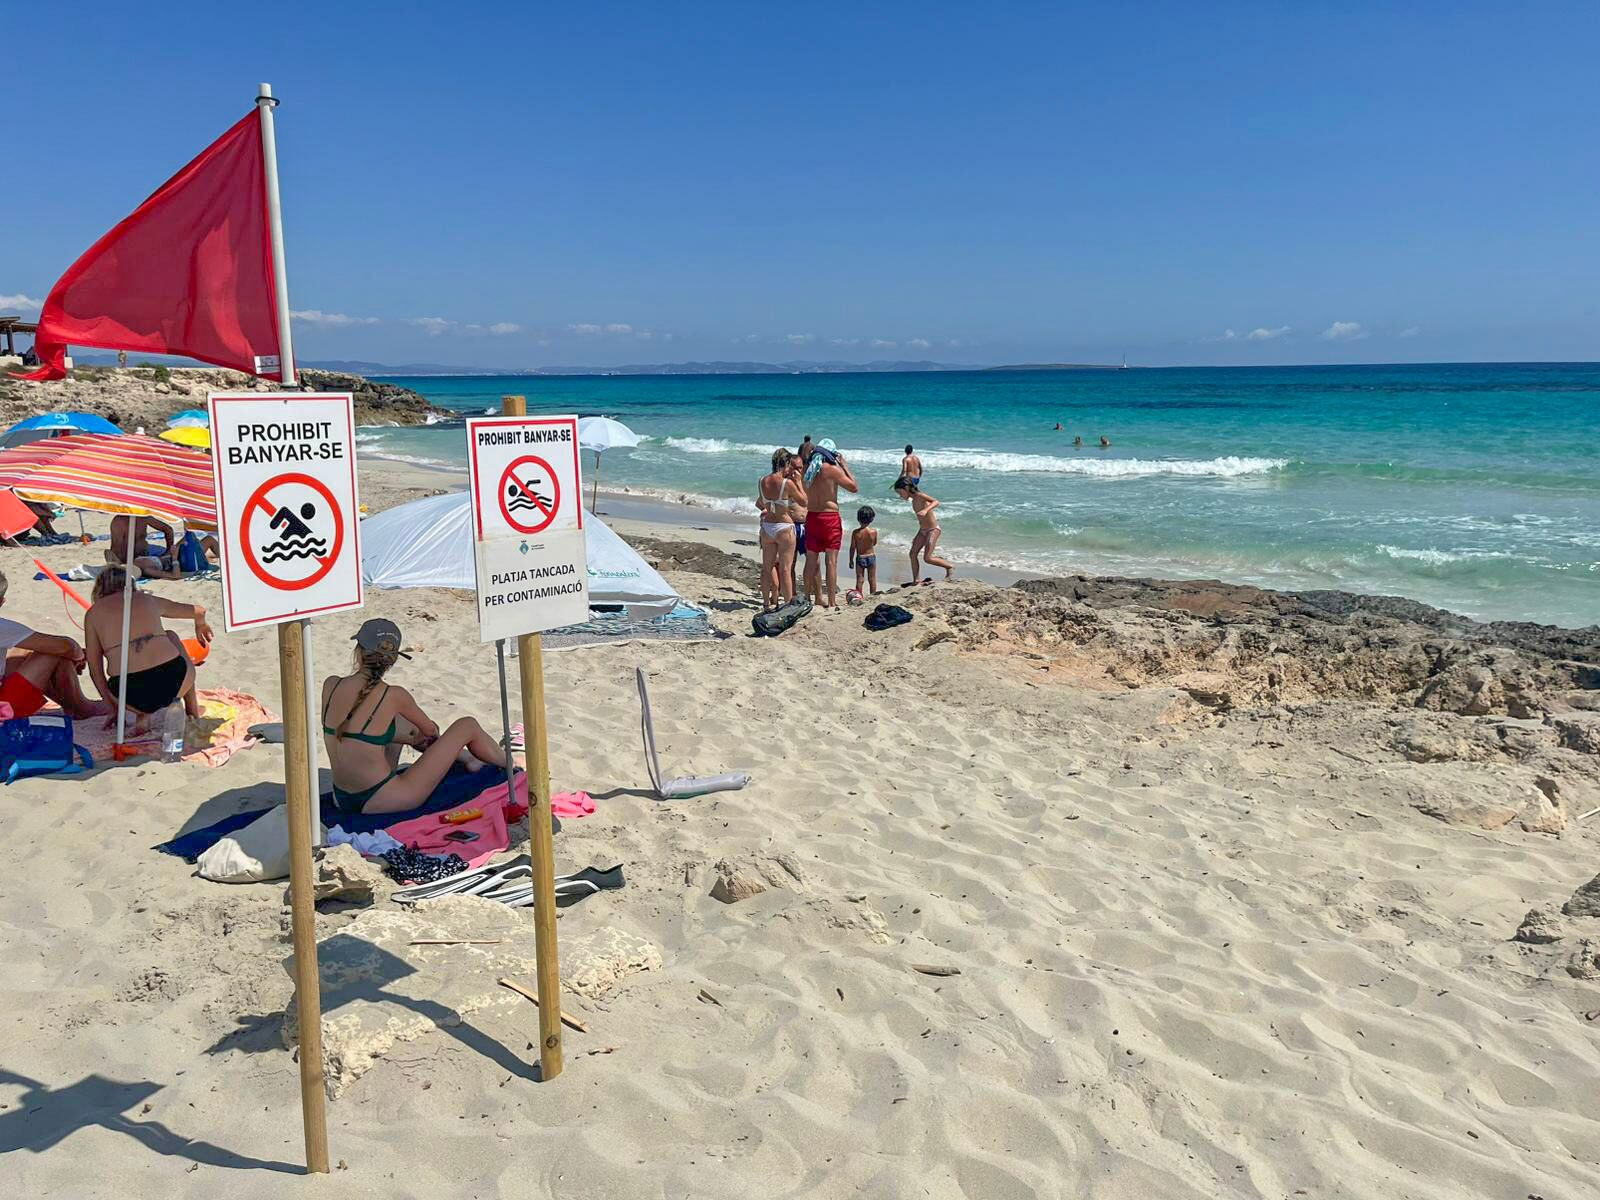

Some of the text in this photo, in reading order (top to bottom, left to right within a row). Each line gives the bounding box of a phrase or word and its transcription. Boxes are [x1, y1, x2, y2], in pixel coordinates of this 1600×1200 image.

[237, 422, 332, 442] PROHIBIT
[478, 429, 572, 446] PROHIBIT BANYAR-SE
[228, 442, 343, 465] BANYAR-SE
[491, 564, 575, 585] PLATJA TANCADA
[484, 579, 583, 607] PER CONTAMINACIÓ
